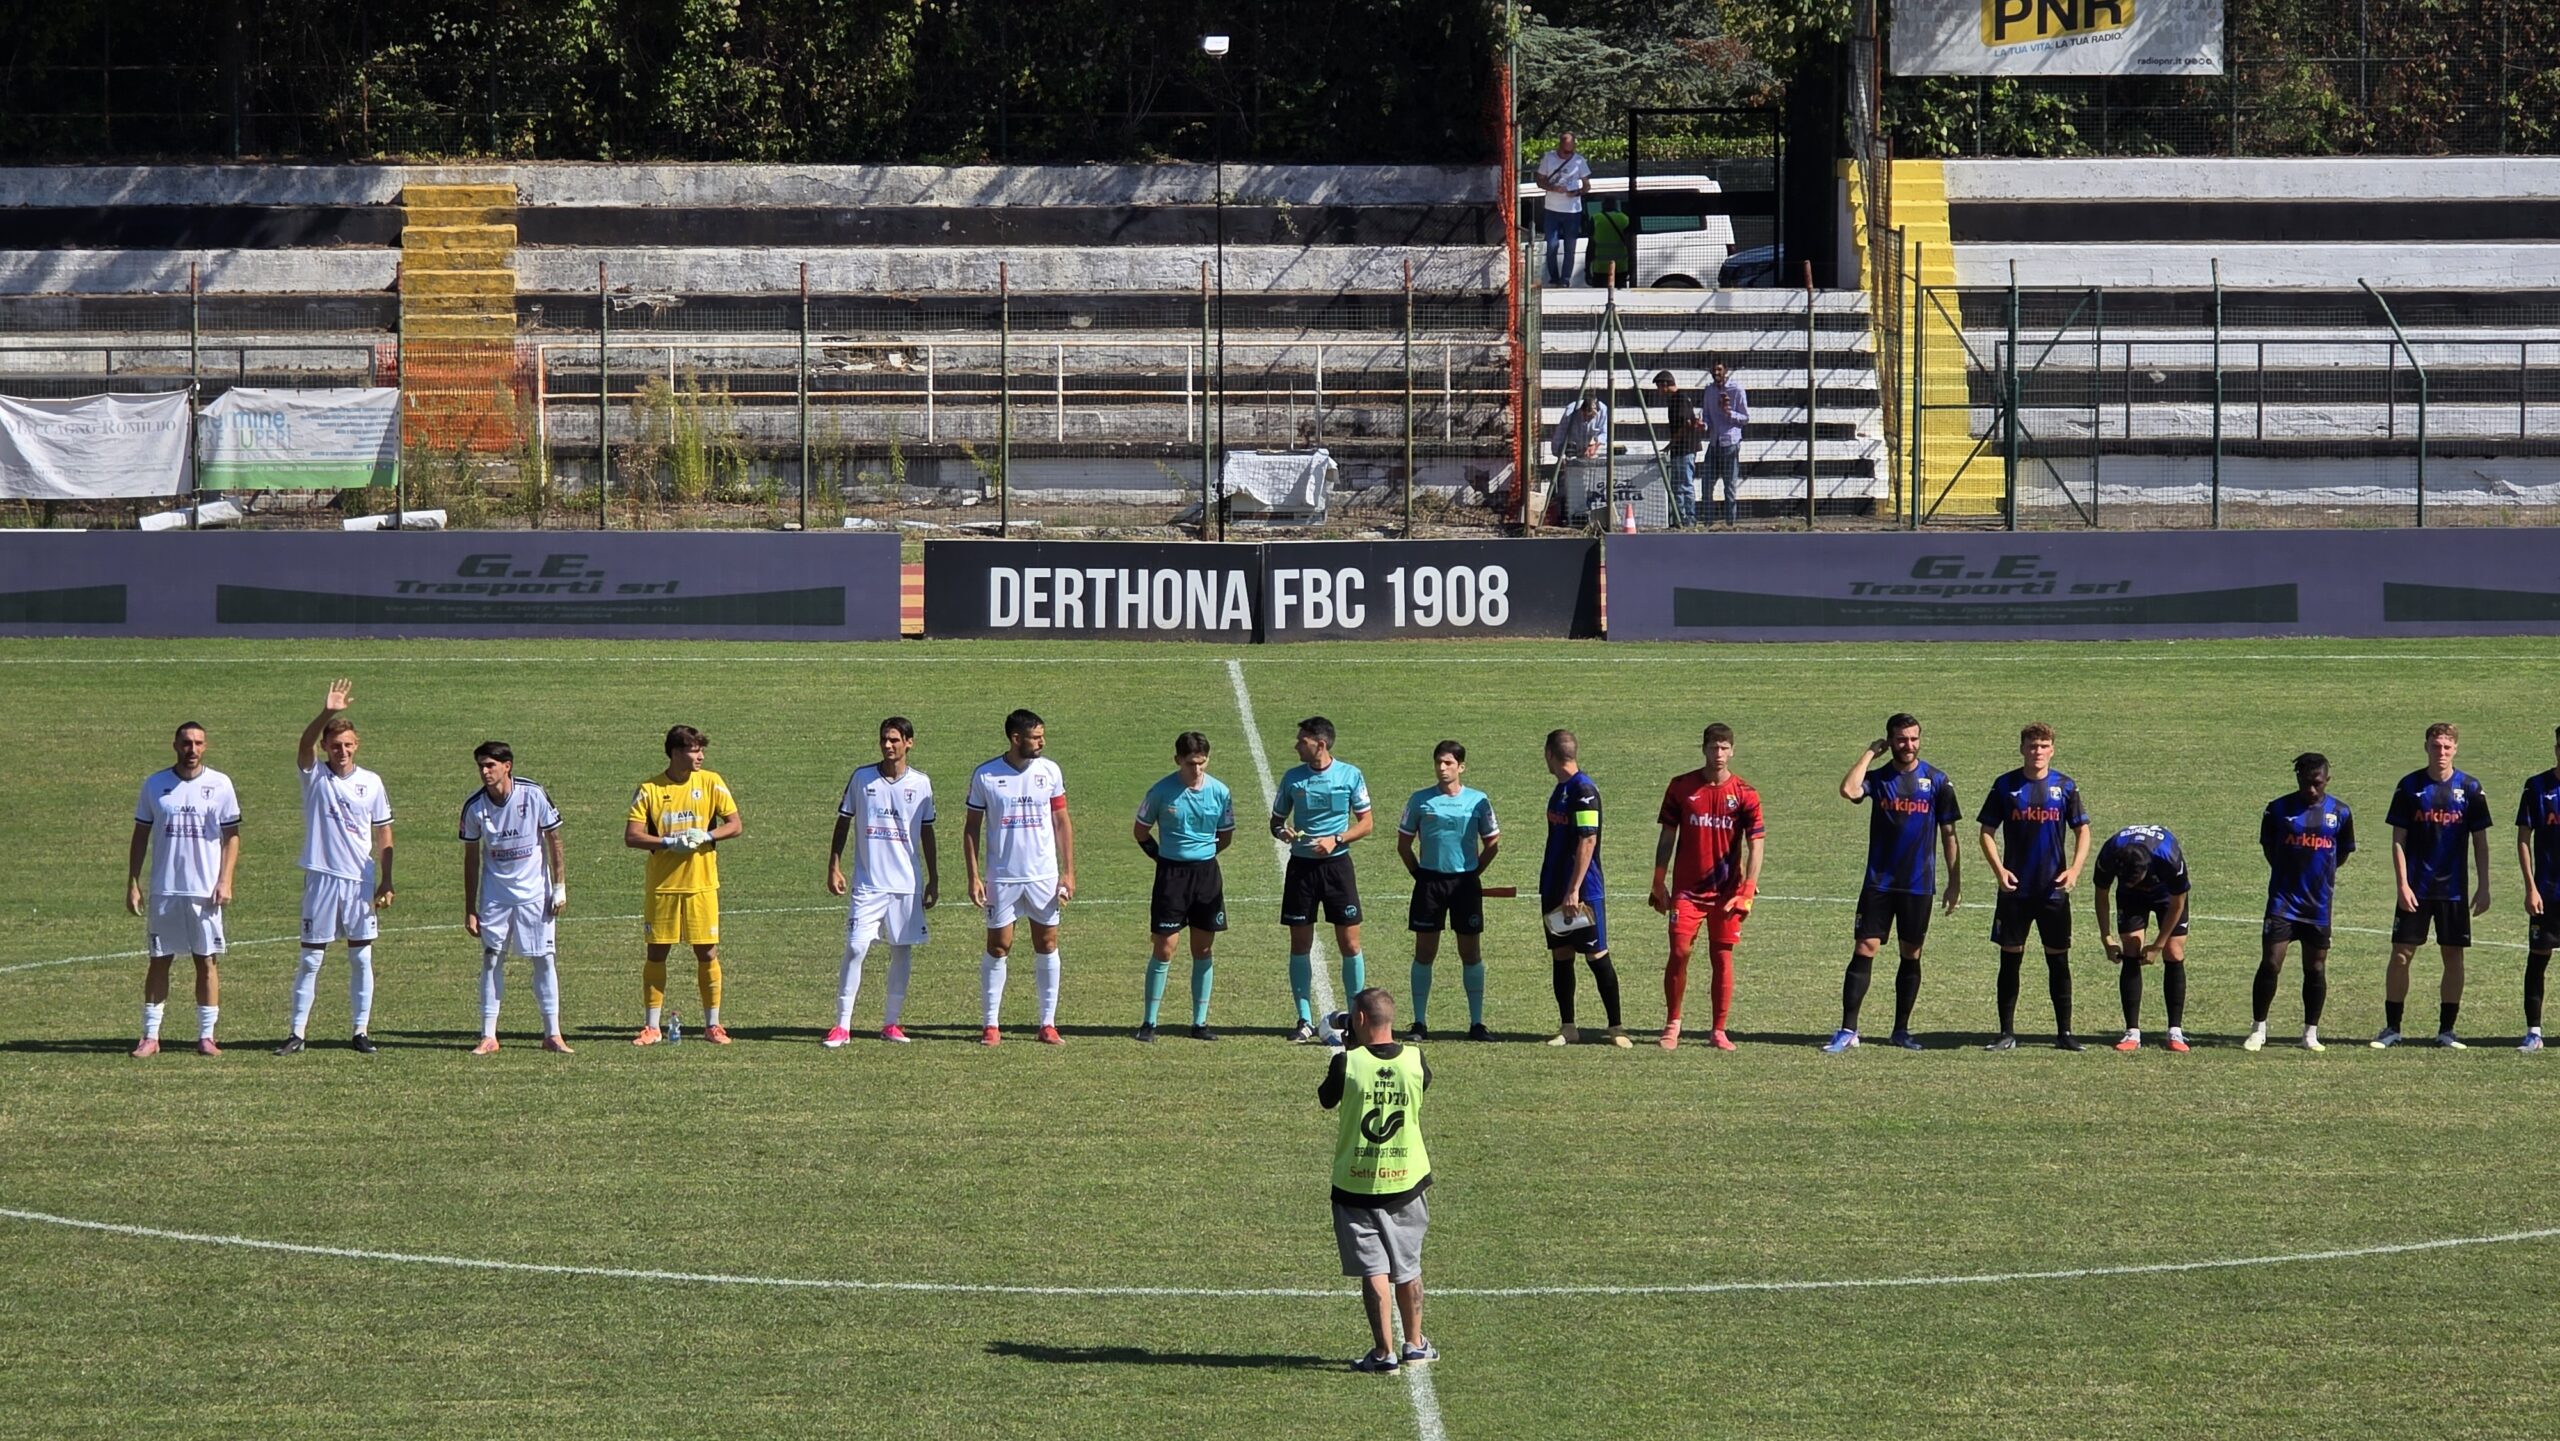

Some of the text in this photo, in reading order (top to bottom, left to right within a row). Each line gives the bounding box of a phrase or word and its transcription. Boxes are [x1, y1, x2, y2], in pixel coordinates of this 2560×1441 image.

[1994, 48, 2007, 57] LA
[2009, 46, 2028, 55] TUA
[2055, 40, 2069, 49] LA
[2070, 37, 2089, 46] TUA
[2137, 57, 2182, 67] radiopnr.it
[457, 554, 604, 577] G.E.
[1910, 555, 2058, 579] G.E.
[393, 580, 680, 596] Trasporti srl
[989, 565, 1510, 630] DERTHONA FBC 1908
[1848, 580, 2132, 598] Trasporti srl
